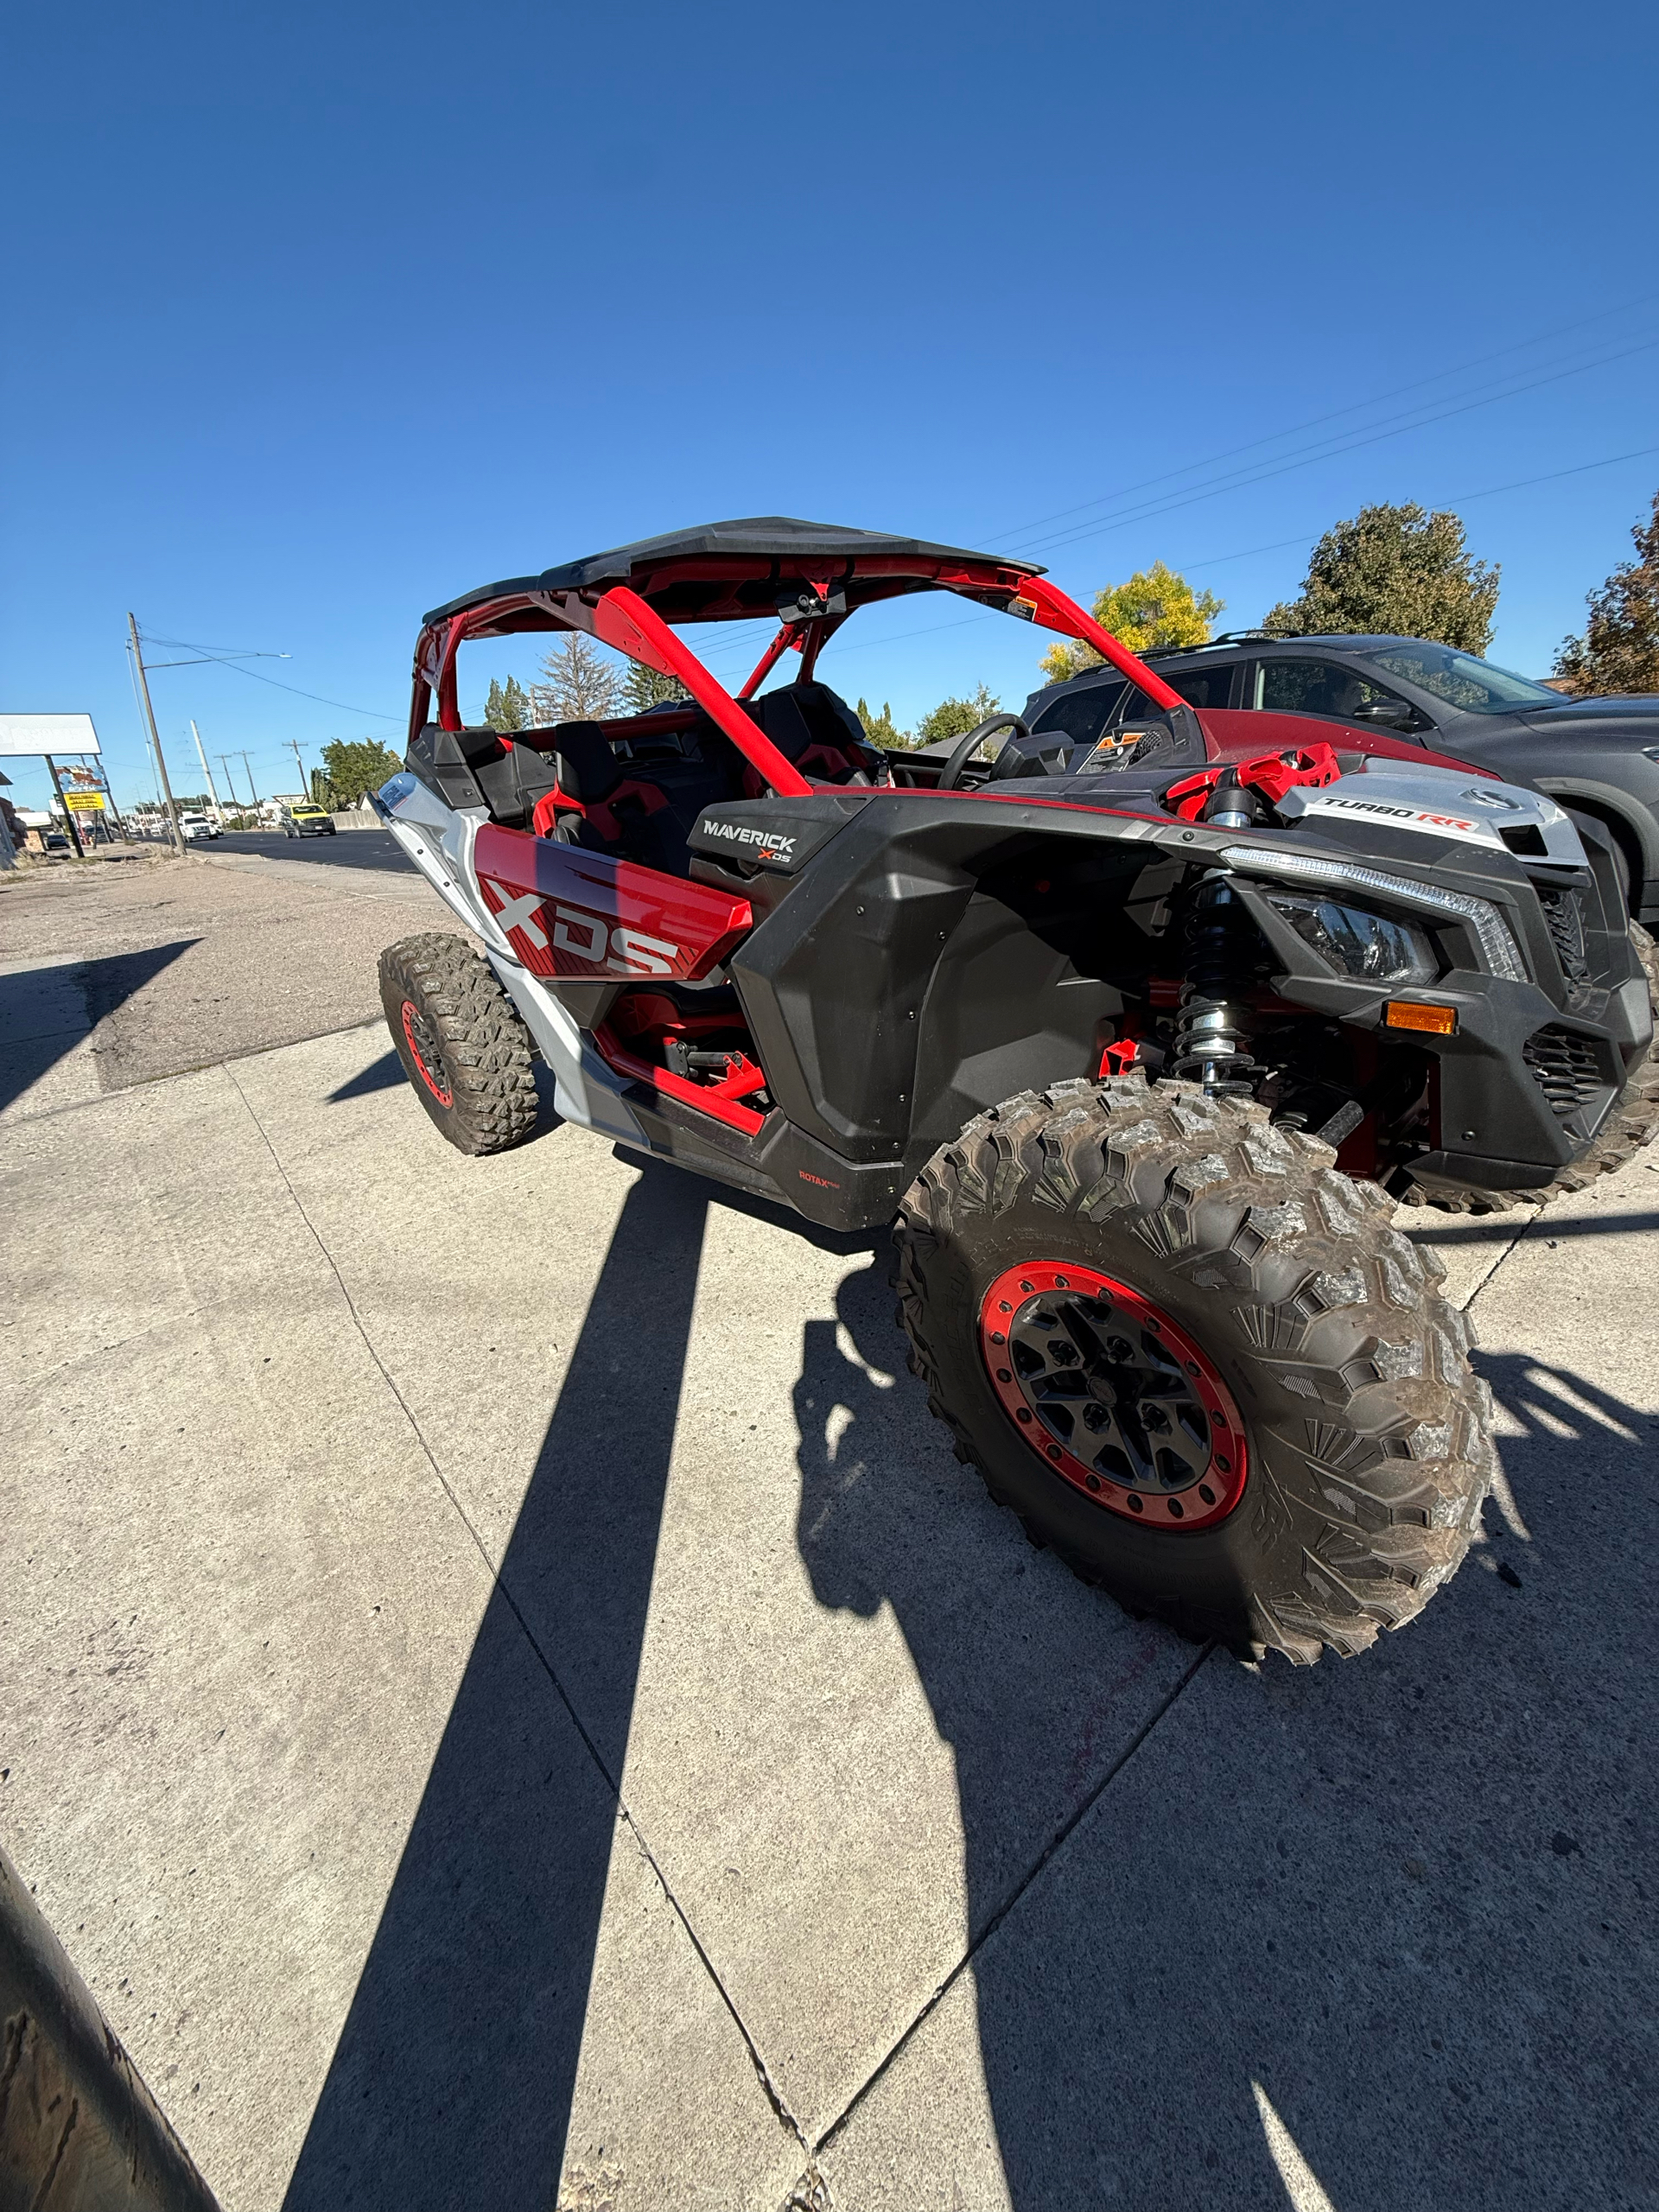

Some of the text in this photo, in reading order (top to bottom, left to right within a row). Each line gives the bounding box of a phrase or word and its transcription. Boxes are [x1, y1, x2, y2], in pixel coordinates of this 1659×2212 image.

[1325, 798, 1473, 831] TURBO RR
[703, 820, 797, 853] MAVERICK
[758, 848, 791, 863] XDS
[486, 879, 678, 974] XDS
[798, 1169, 829, 1188] ROTAX
